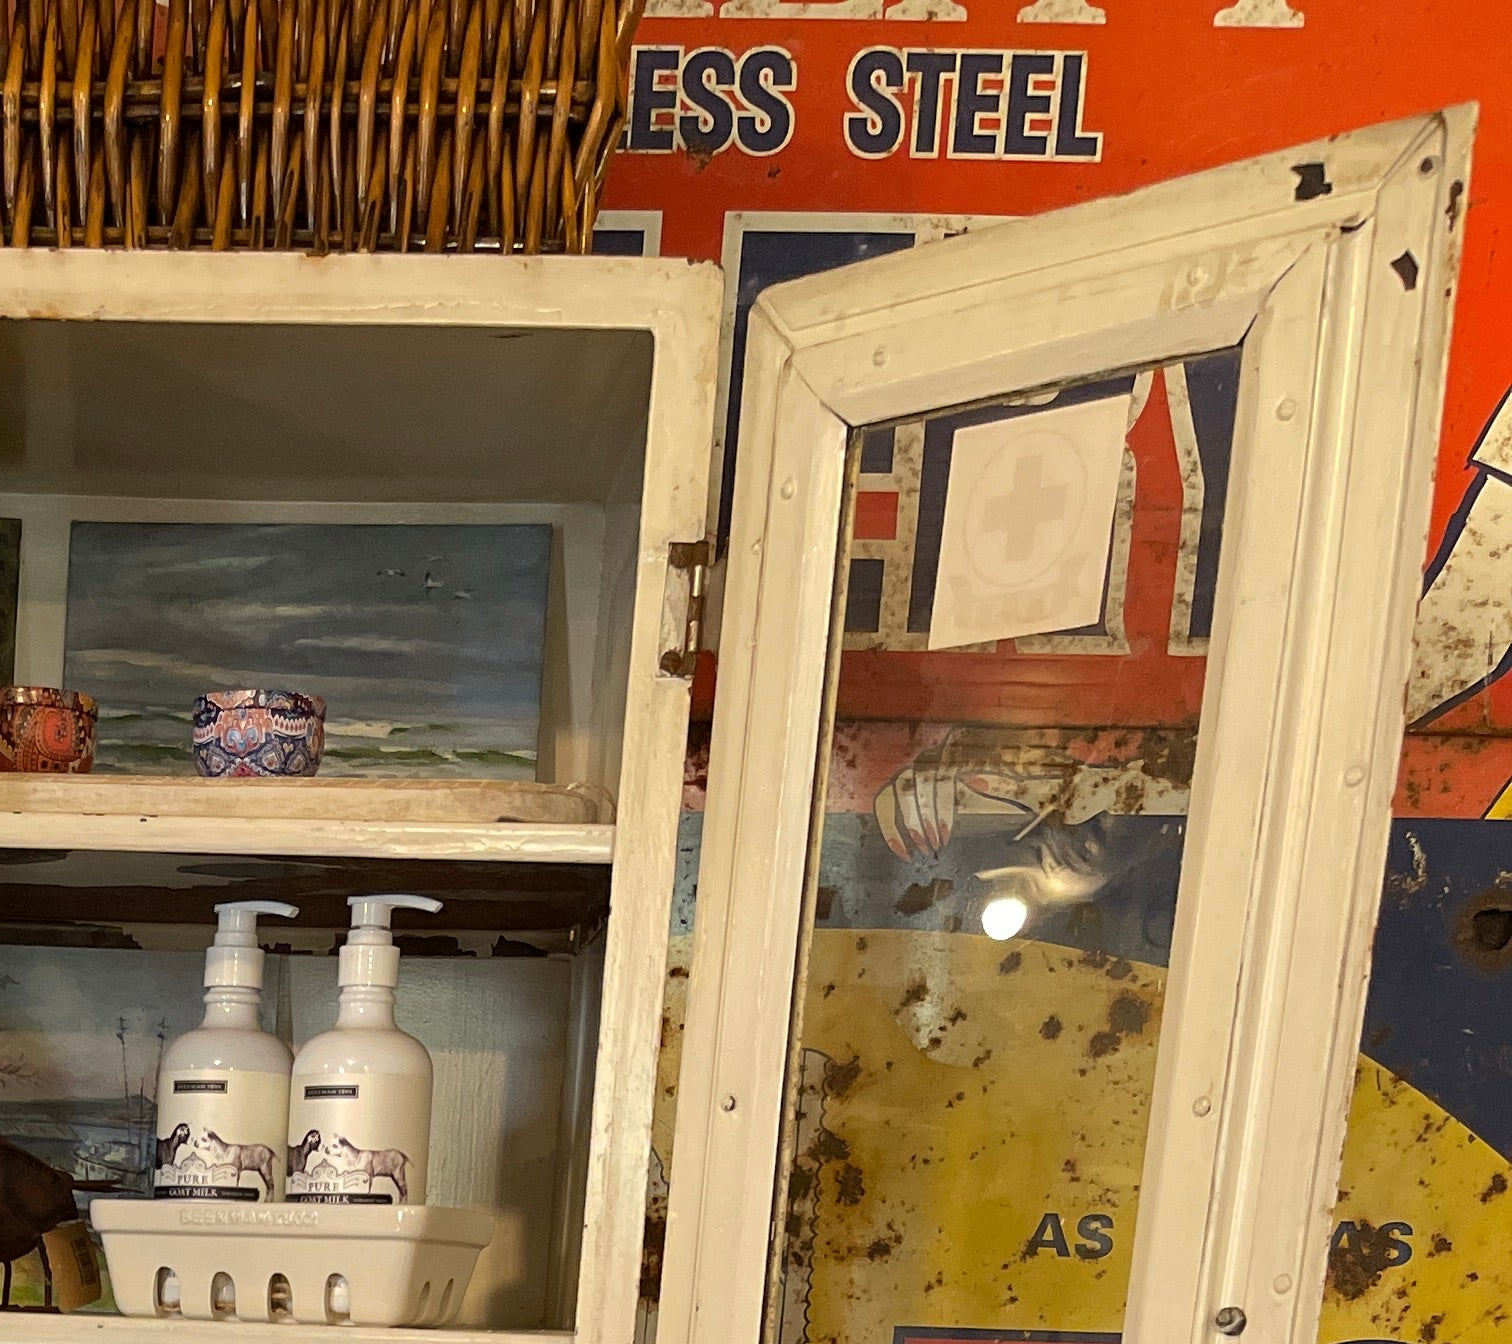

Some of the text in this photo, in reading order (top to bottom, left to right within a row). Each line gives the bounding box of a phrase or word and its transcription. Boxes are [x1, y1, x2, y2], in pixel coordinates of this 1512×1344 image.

[618, 45, 1104, 162] ESS STEEL
[177, 1174, 209, 1185] PURE
[168, 1187, 192, 1197] GOAT
[192, 1188, 218, 1198] MILK
[308, 1182, 340, 1192] PURE
[324, 1195, 350, 1204] MILK
[1023, 1212, 1115, 1260] AS
